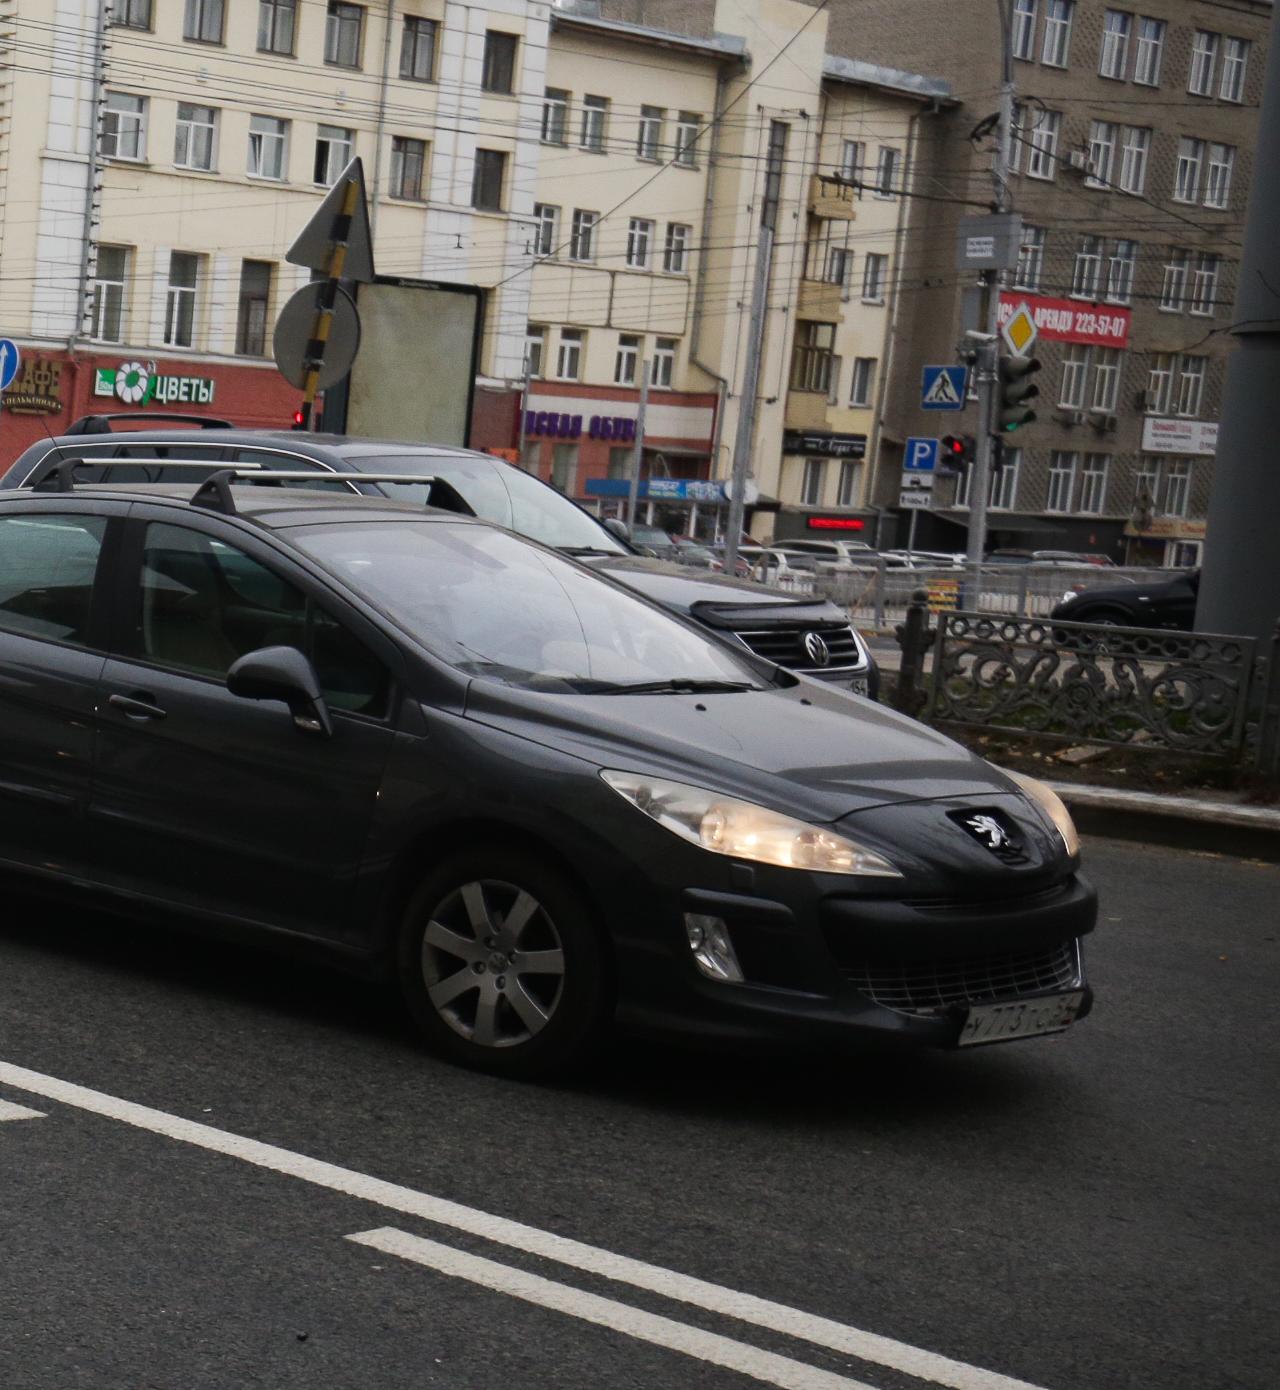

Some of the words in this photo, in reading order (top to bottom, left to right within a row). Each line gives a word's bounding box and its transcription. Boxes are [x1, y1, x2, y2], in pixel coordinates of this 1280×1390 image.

[1034, 306, 1073, 332] АРЕНДУ
[1075, 313, 1126, 337] 223-57-07
[155, 376, 214, 404] ЦВЕТЫ
[912, 441, 931, 467] P
